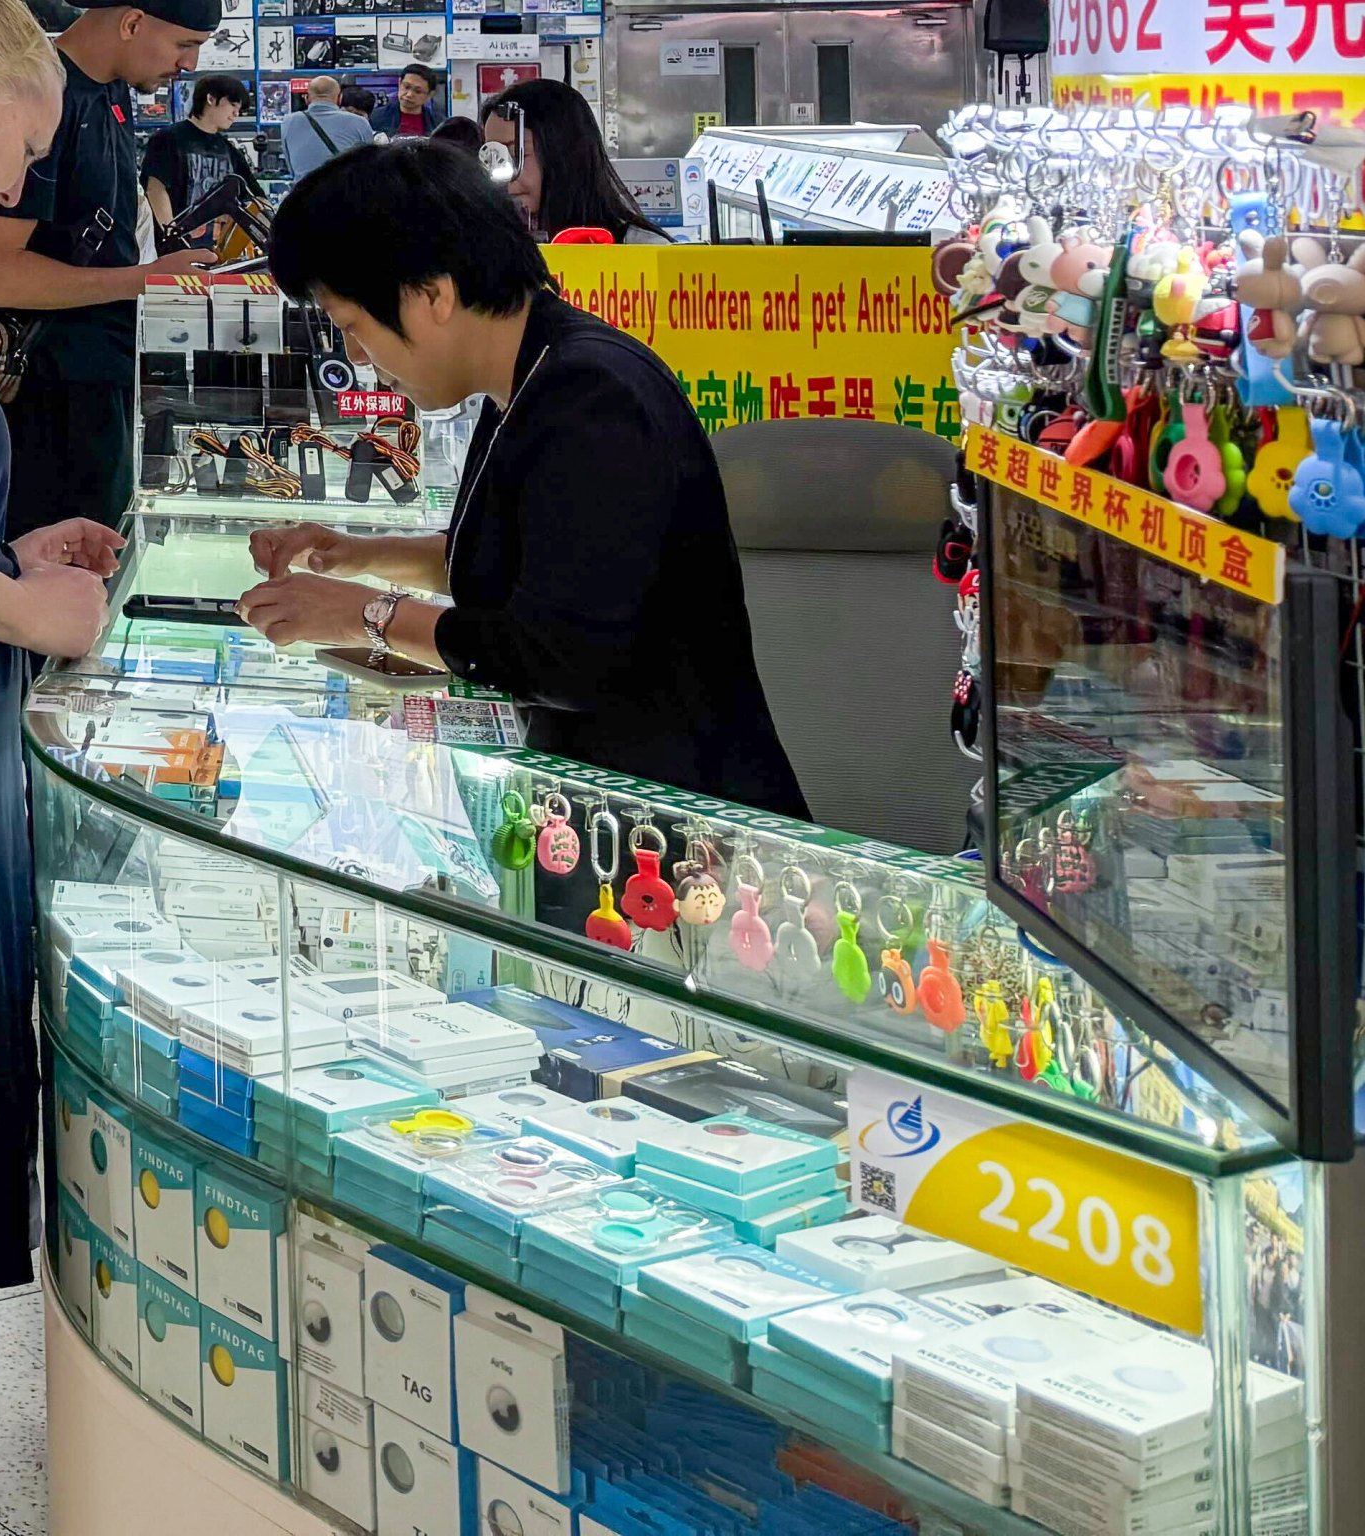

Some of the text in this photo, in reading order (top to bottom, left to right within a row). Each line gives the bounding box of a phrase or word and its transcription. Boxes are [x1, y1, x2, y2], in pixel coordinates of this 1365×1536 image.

[589, 272, 657, 345] elderly
[669, 273, 751, 331] children
[763, 274, 800, 331] and
[813, 282, 846, 348] pet
[857, 276, 952, 335] Anti-lost
[339, 394, 404, 414] 红外探测仪
[978, 432, 1253, 586] 英超世界杯机顶盒
[139, 1148, 184, 1181] FINDTAG
[205, 1185, 259, 1222] FINDTAG
[977, 1160, 1176, 1287] 2208
[95, 1239, 130, 1275] FINDTAG
[146, 1280, 191, 1318] FINDTAG
[210, 1322, 265, 1361] FINDTAG
[402, 1374, 432, 1403] TAG
